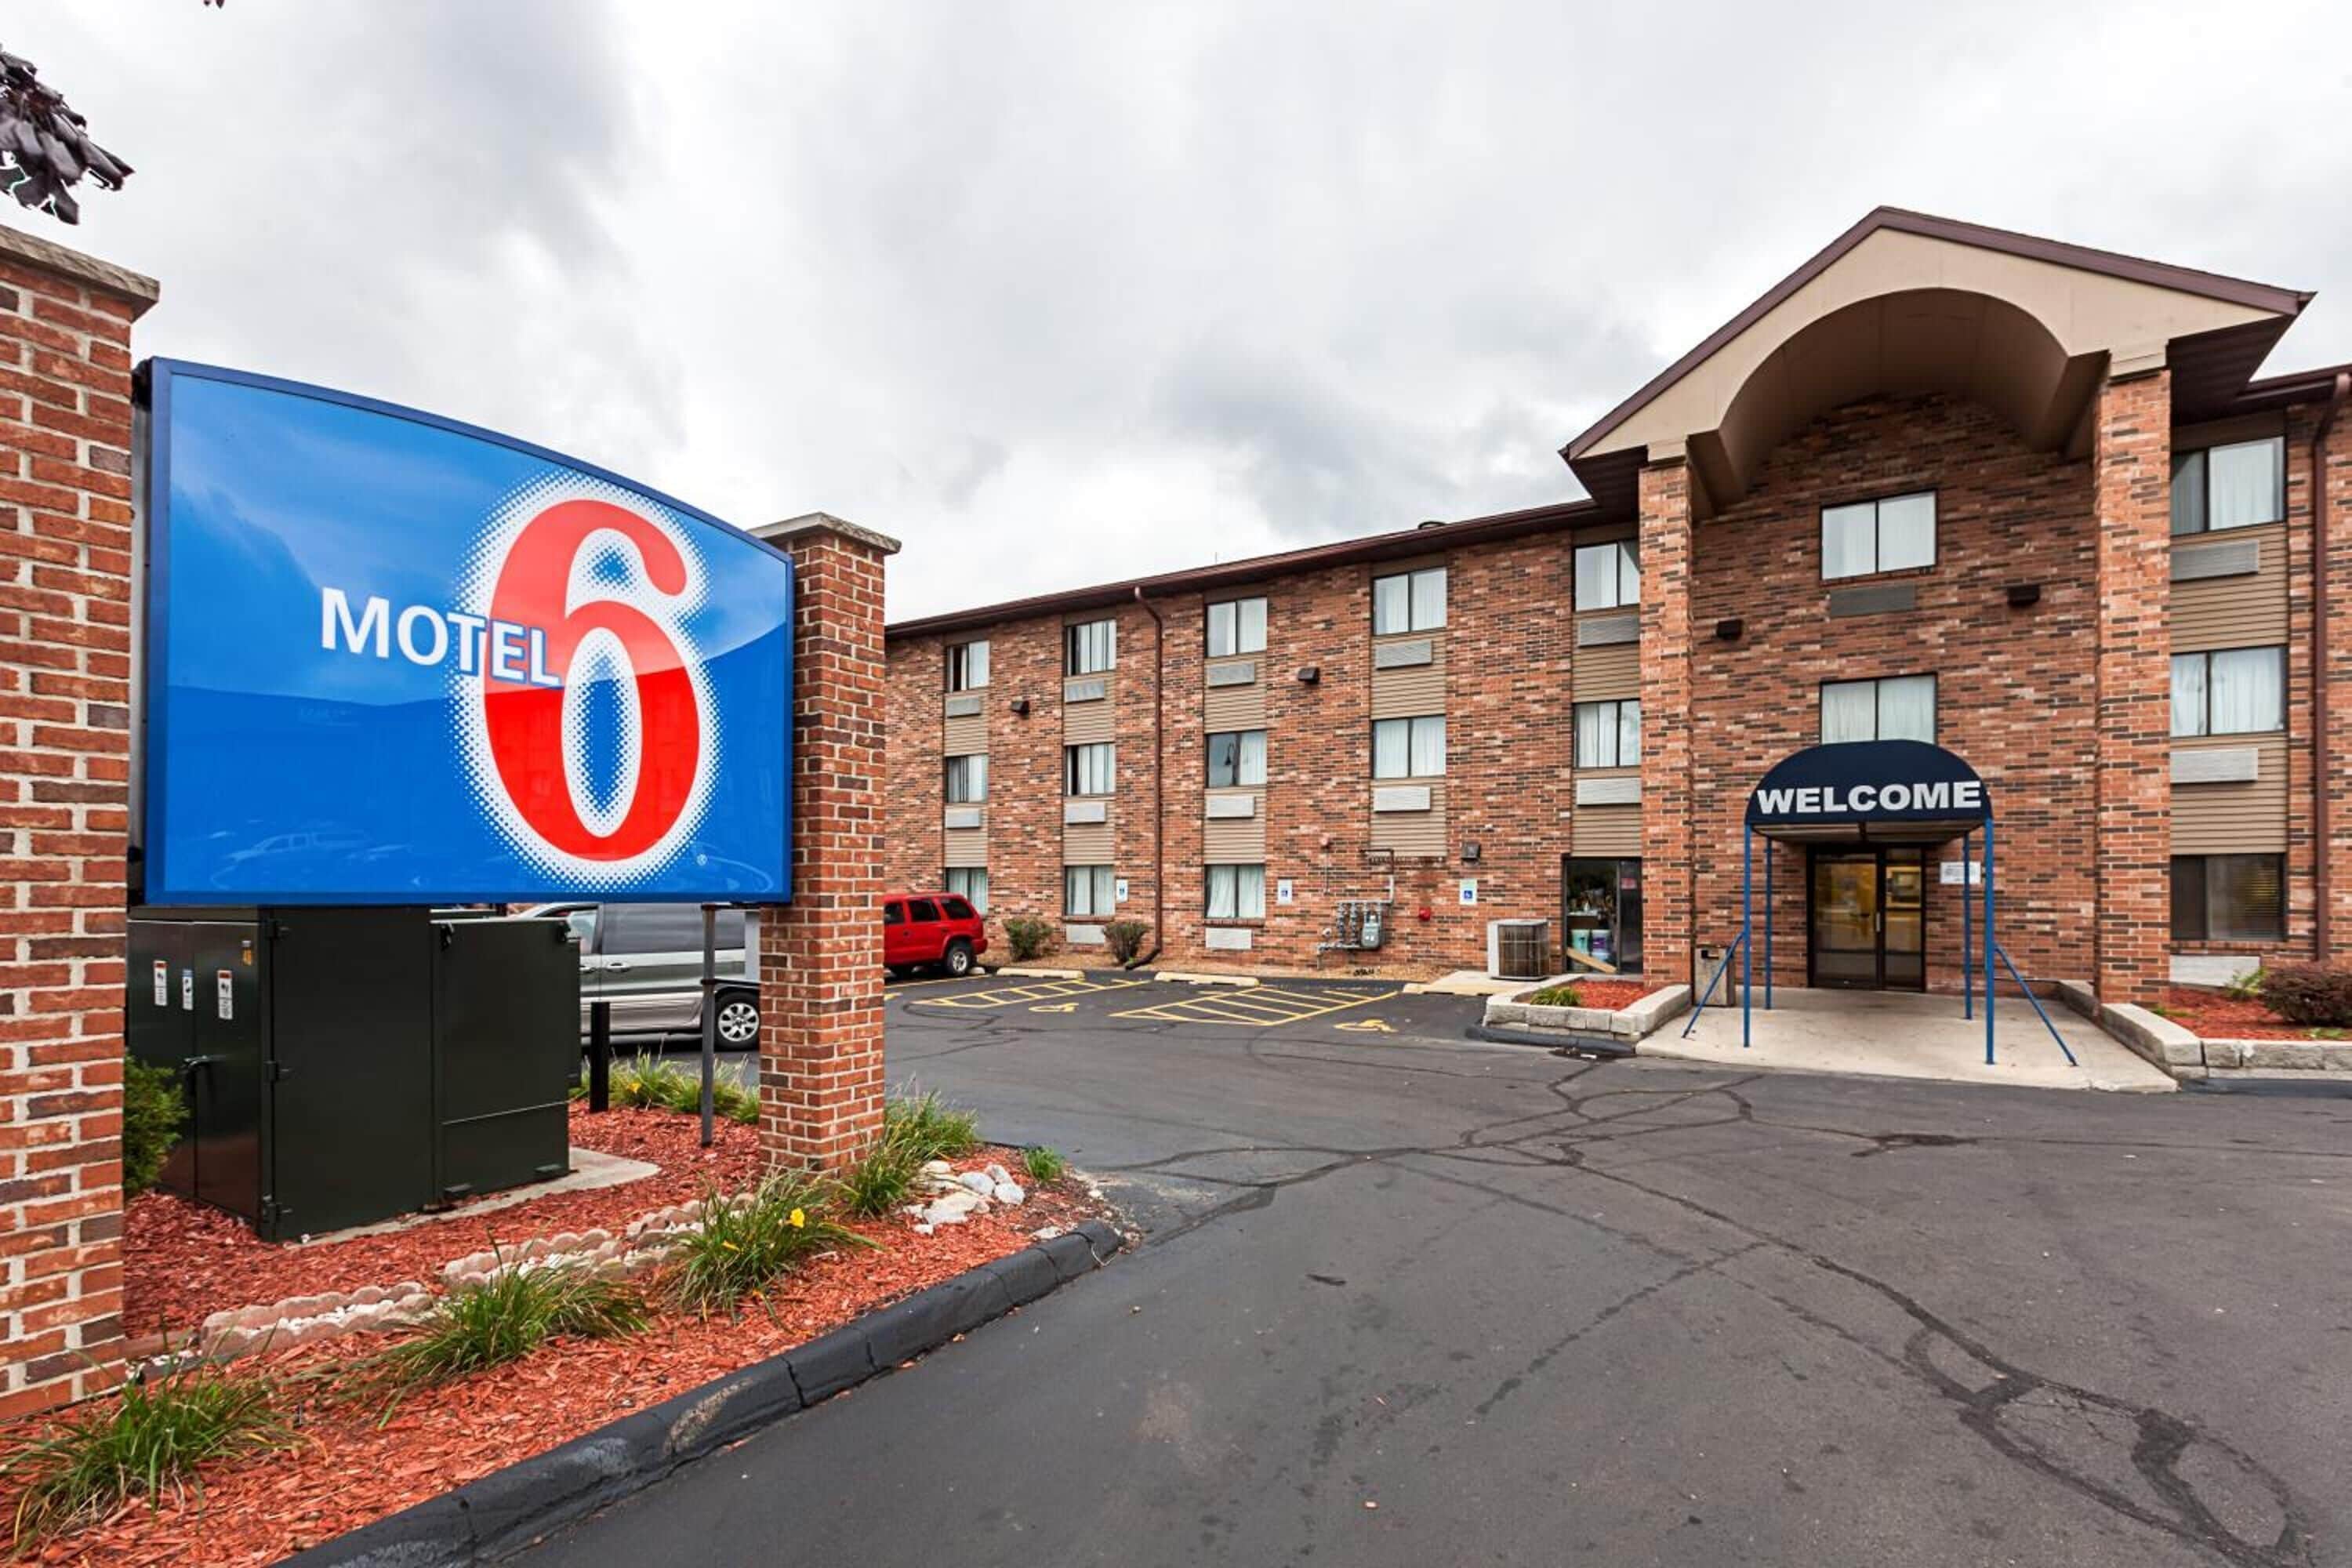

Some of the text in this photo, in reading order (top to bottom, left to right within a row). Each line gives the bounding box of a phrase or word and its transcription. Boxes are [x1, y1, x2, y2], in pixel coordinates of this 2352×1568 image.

[321, 499, 700, 862] MOTEL 6
[1757, 781, 1981, 814] WELCOME
